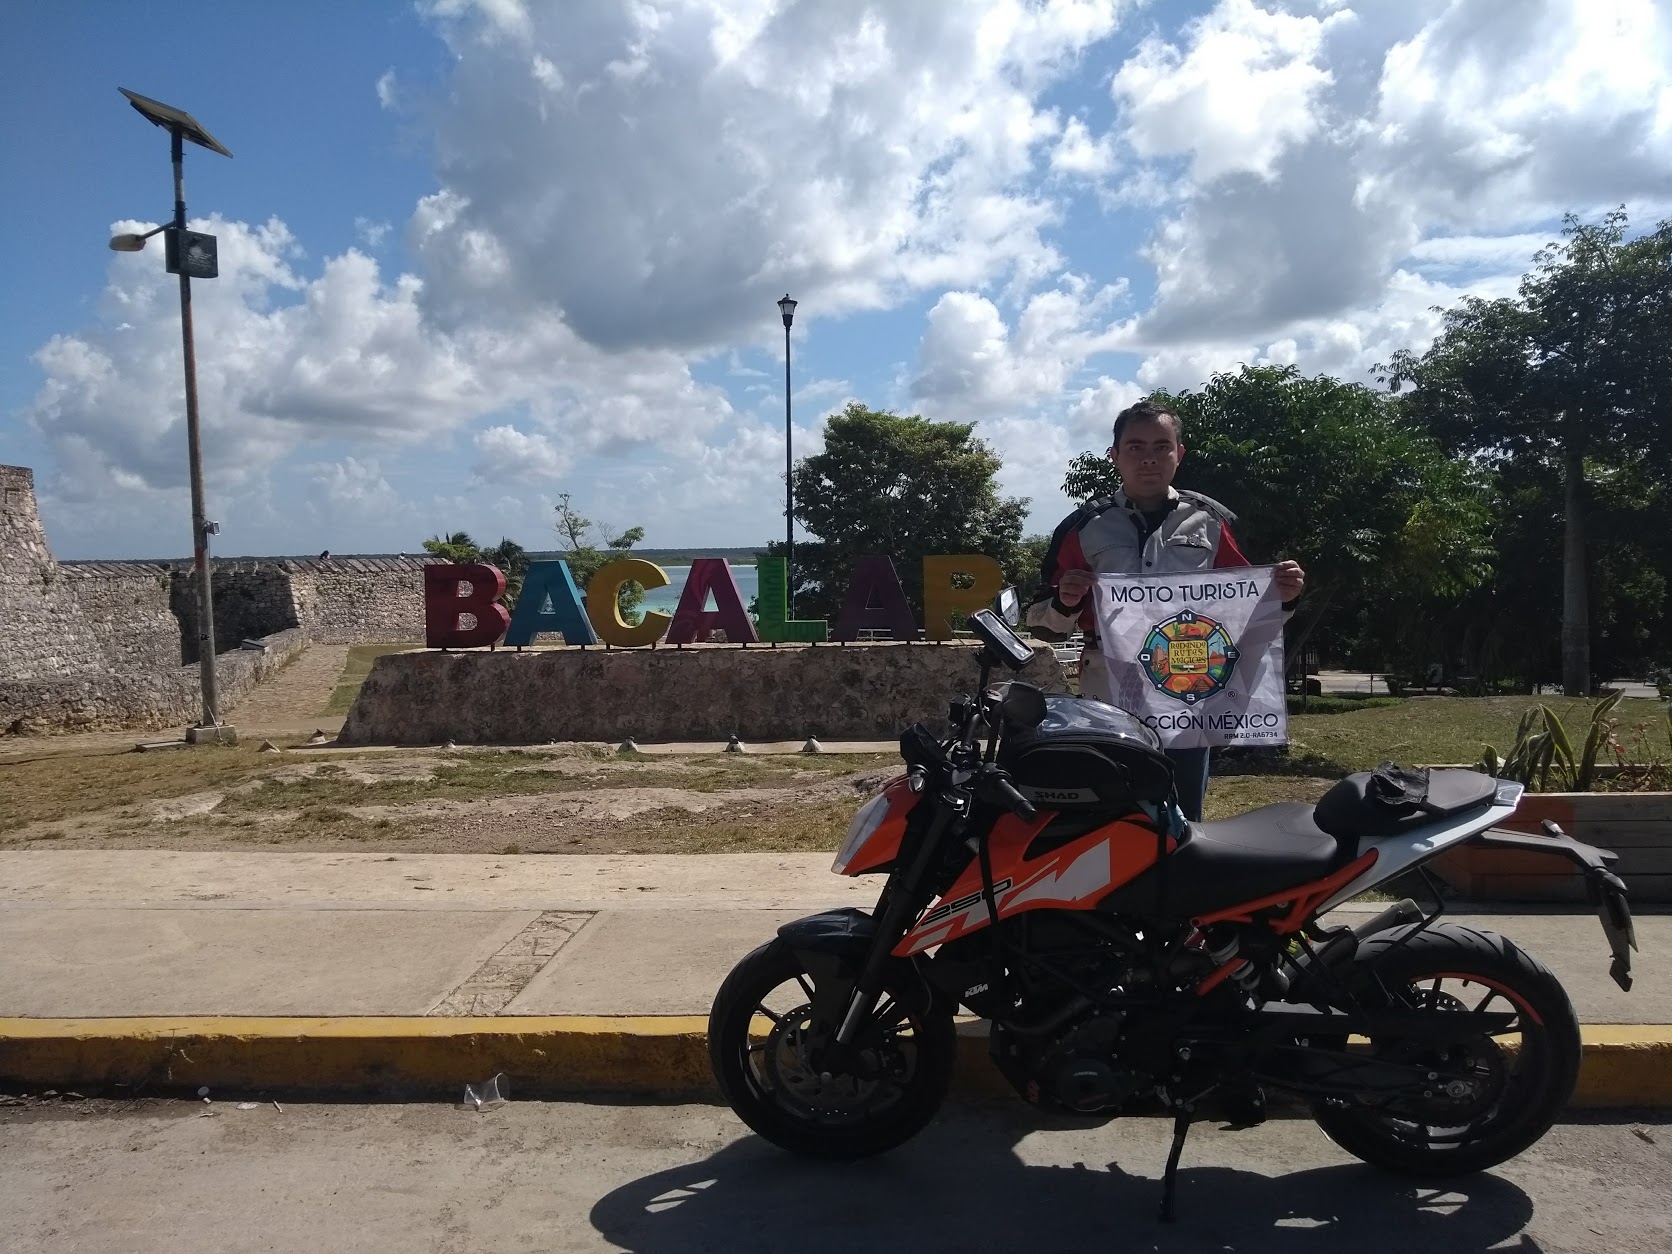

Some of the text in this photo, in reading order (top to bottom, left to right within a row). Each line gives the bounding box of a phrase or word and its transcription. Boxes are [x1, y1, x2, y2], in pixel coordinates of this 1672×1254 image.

[1111, 580, 1259, 603] MOTO TURISTA
[1181, 613, 1192, 621] N
[1227, 651, 1236, 659] E
[1186, 693, 1195, 701] S
[1144, 710, 1279, 730] CCIÓN MÉXICO
[1034, 791, 1080, 800] SHAD
[964, 983, 989, 998] KTM
